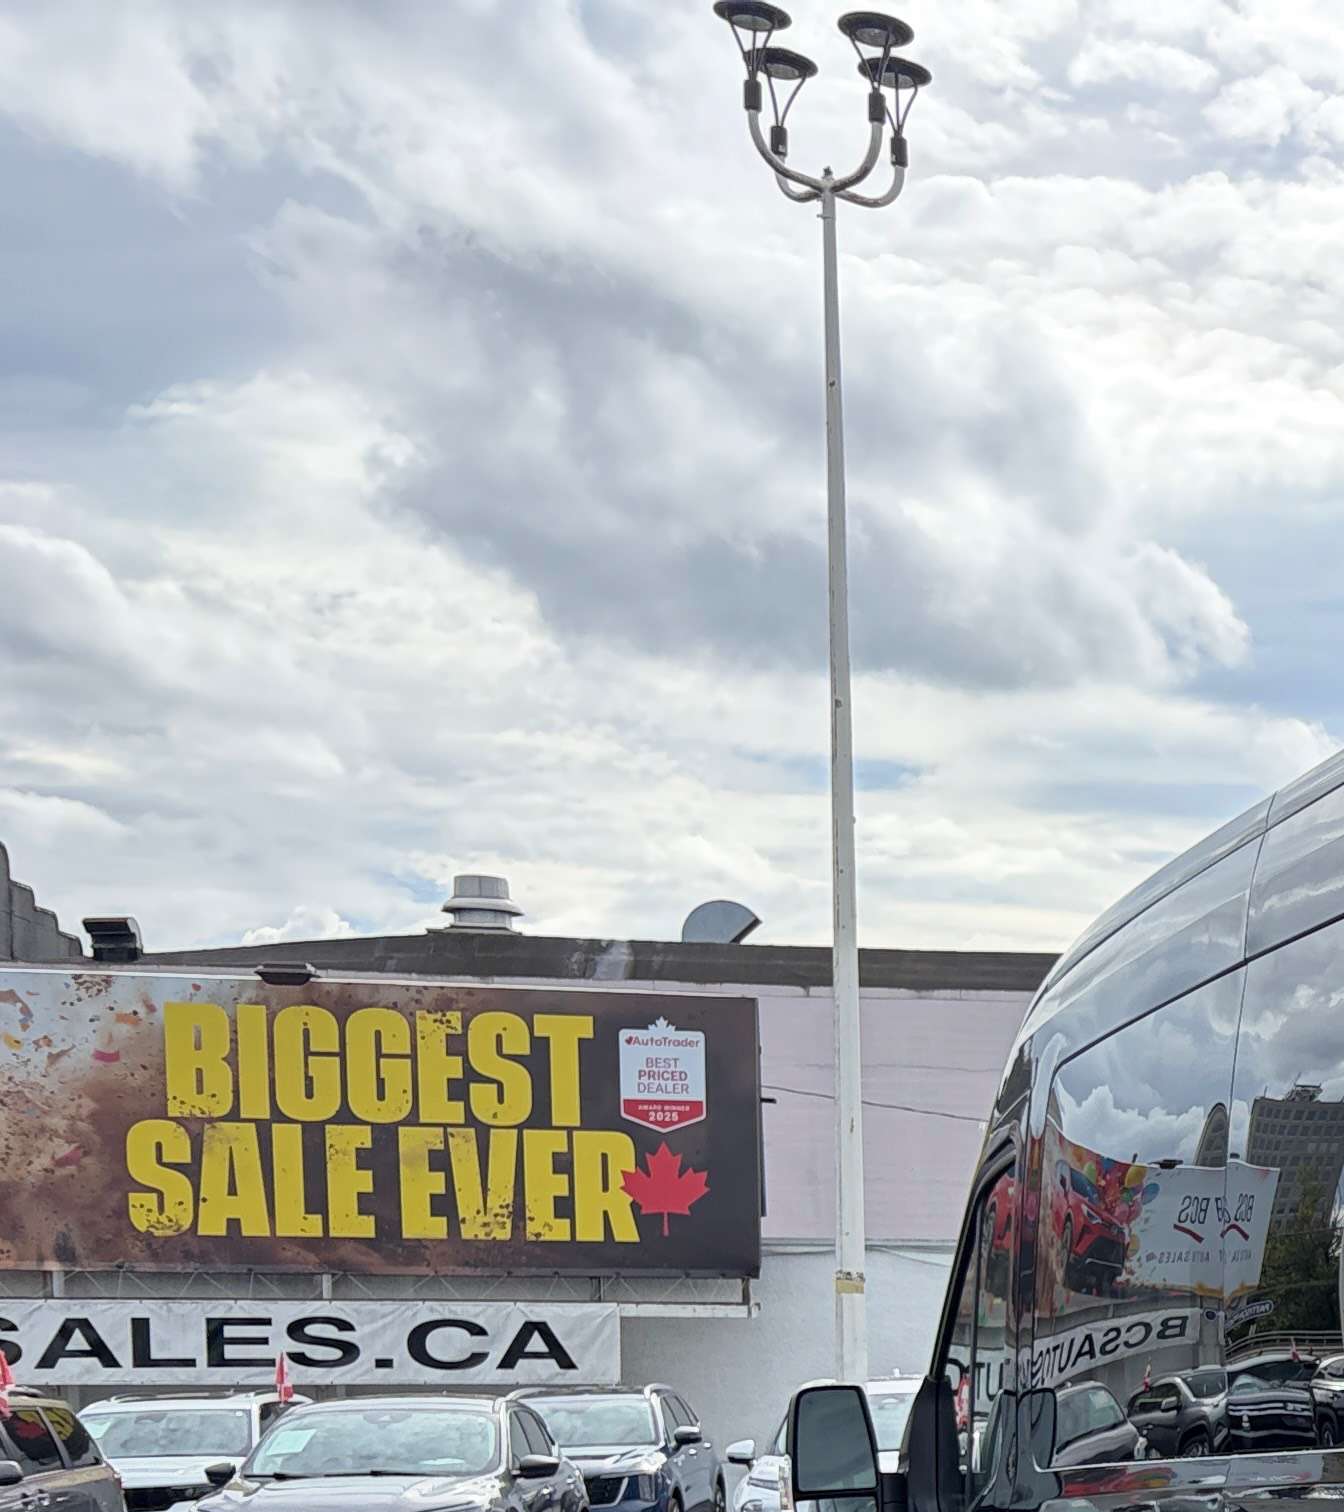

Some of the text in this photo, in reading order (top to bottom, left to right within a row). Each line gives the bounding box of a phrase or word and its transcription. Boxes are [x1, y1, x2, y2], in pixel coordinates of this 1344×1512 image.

[632, 1036, 700, 1048] AutoTrader
[163, 1002, 594, 1127] BIGGEST
[645, 1057, 680, 1069] BEST
[638, 1070, 688, 1082] PRICED
[637, 1082, 690, 1095] DEALER
[648, 1111, 679, 1122] 2025
[126, 1119, 641, 1242] SALE EVER
